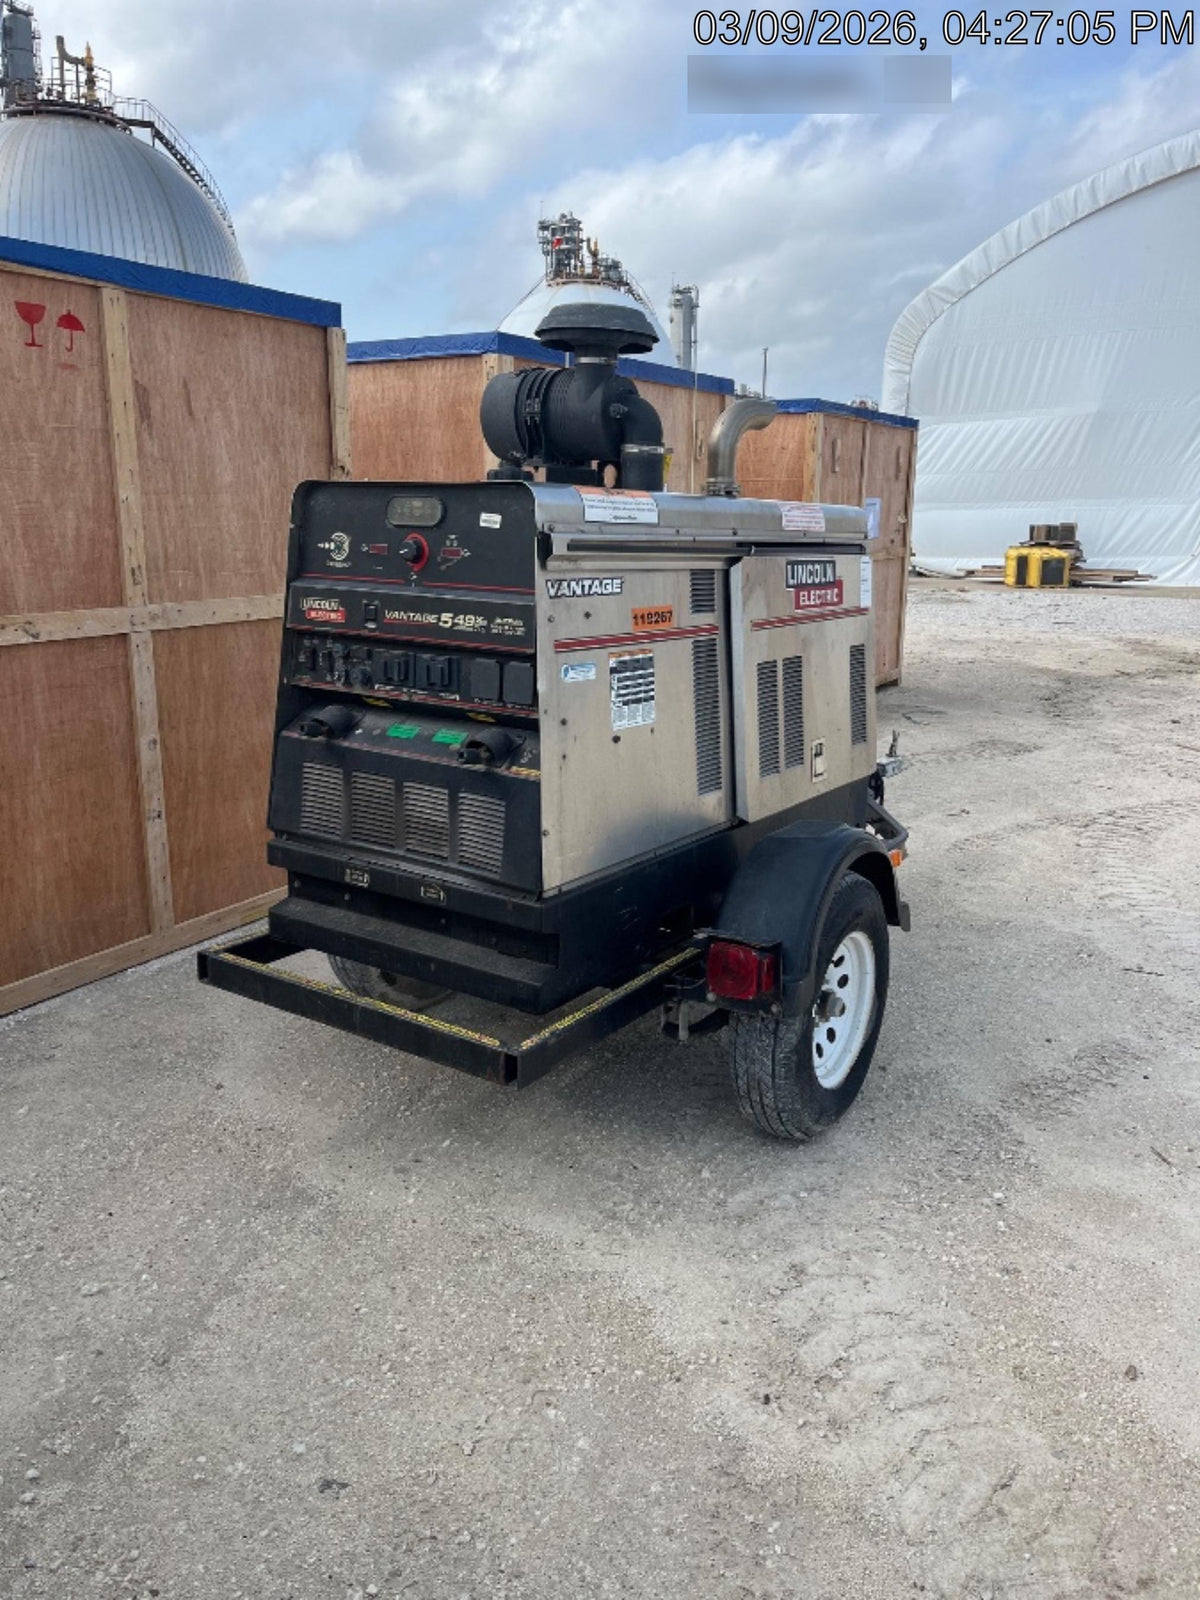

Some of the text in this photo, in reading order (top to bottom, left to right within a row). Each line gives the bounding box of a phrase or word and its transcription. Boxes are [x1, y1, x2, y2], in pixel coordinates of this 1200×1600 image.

[787, 562, 835, 586] LINCOLN
[546, 578, 623, 597] VANTAGE
[384, 608, 439, 623] VANTAGE
